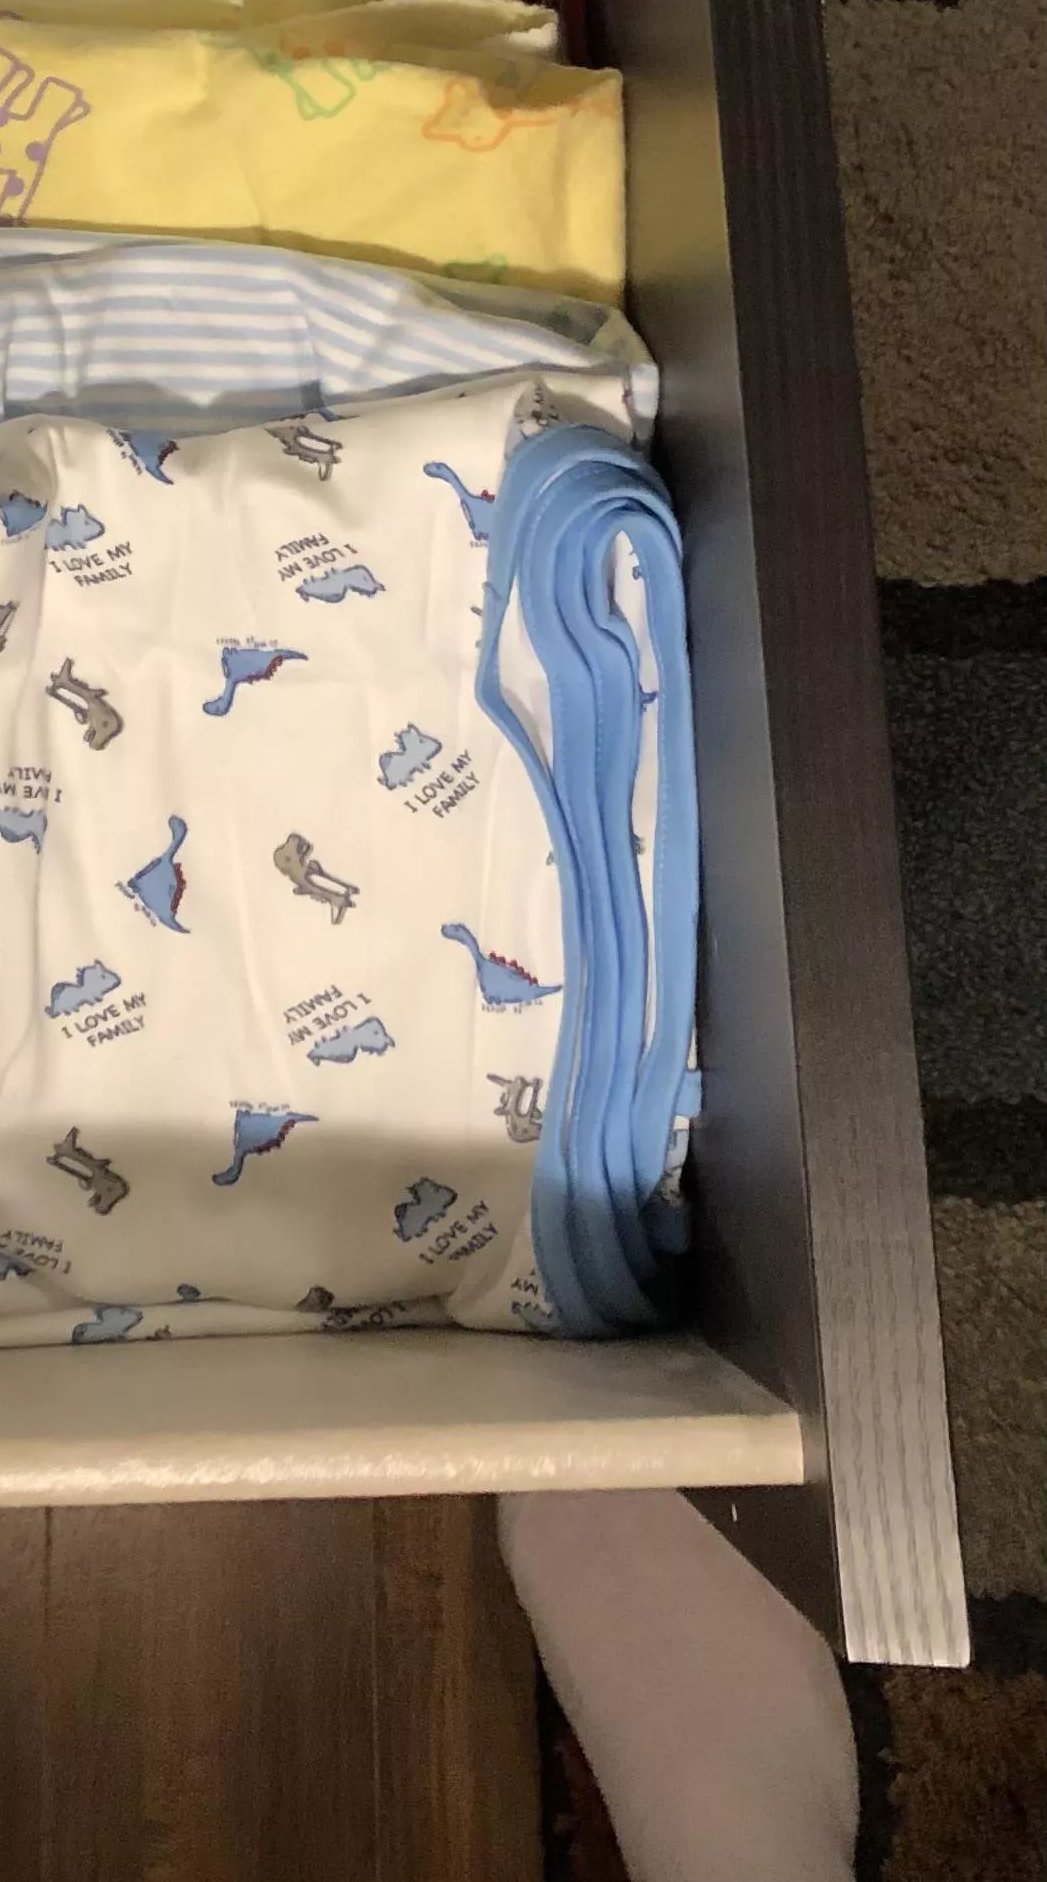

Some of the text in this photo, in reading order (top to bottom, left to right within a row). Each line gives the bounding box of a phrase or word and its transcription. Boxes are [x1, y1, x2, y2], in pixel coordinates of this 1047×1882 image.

[49, 541, 132, 573] I LOVE MY
[275, 532, 329, 562] FAMILY
[278, 544, 358, 582] I LOVE MY
[74, 562, 132, 587] FAMILY
[404, 750, 471, 813] I LOVE MY
[433, 772, 480, 818] FAMILY
[61, 992, 146, 1039] I LOVE MY
[283, 985, 342, 1023] FAMILY
[288, 993, 372, 1045] I LOVE MY
[87, 1015, 144, 1047] FAMILY
[428, 1221, 468, 1255] LOVE
[467, 1200, 489, 1224] MY
